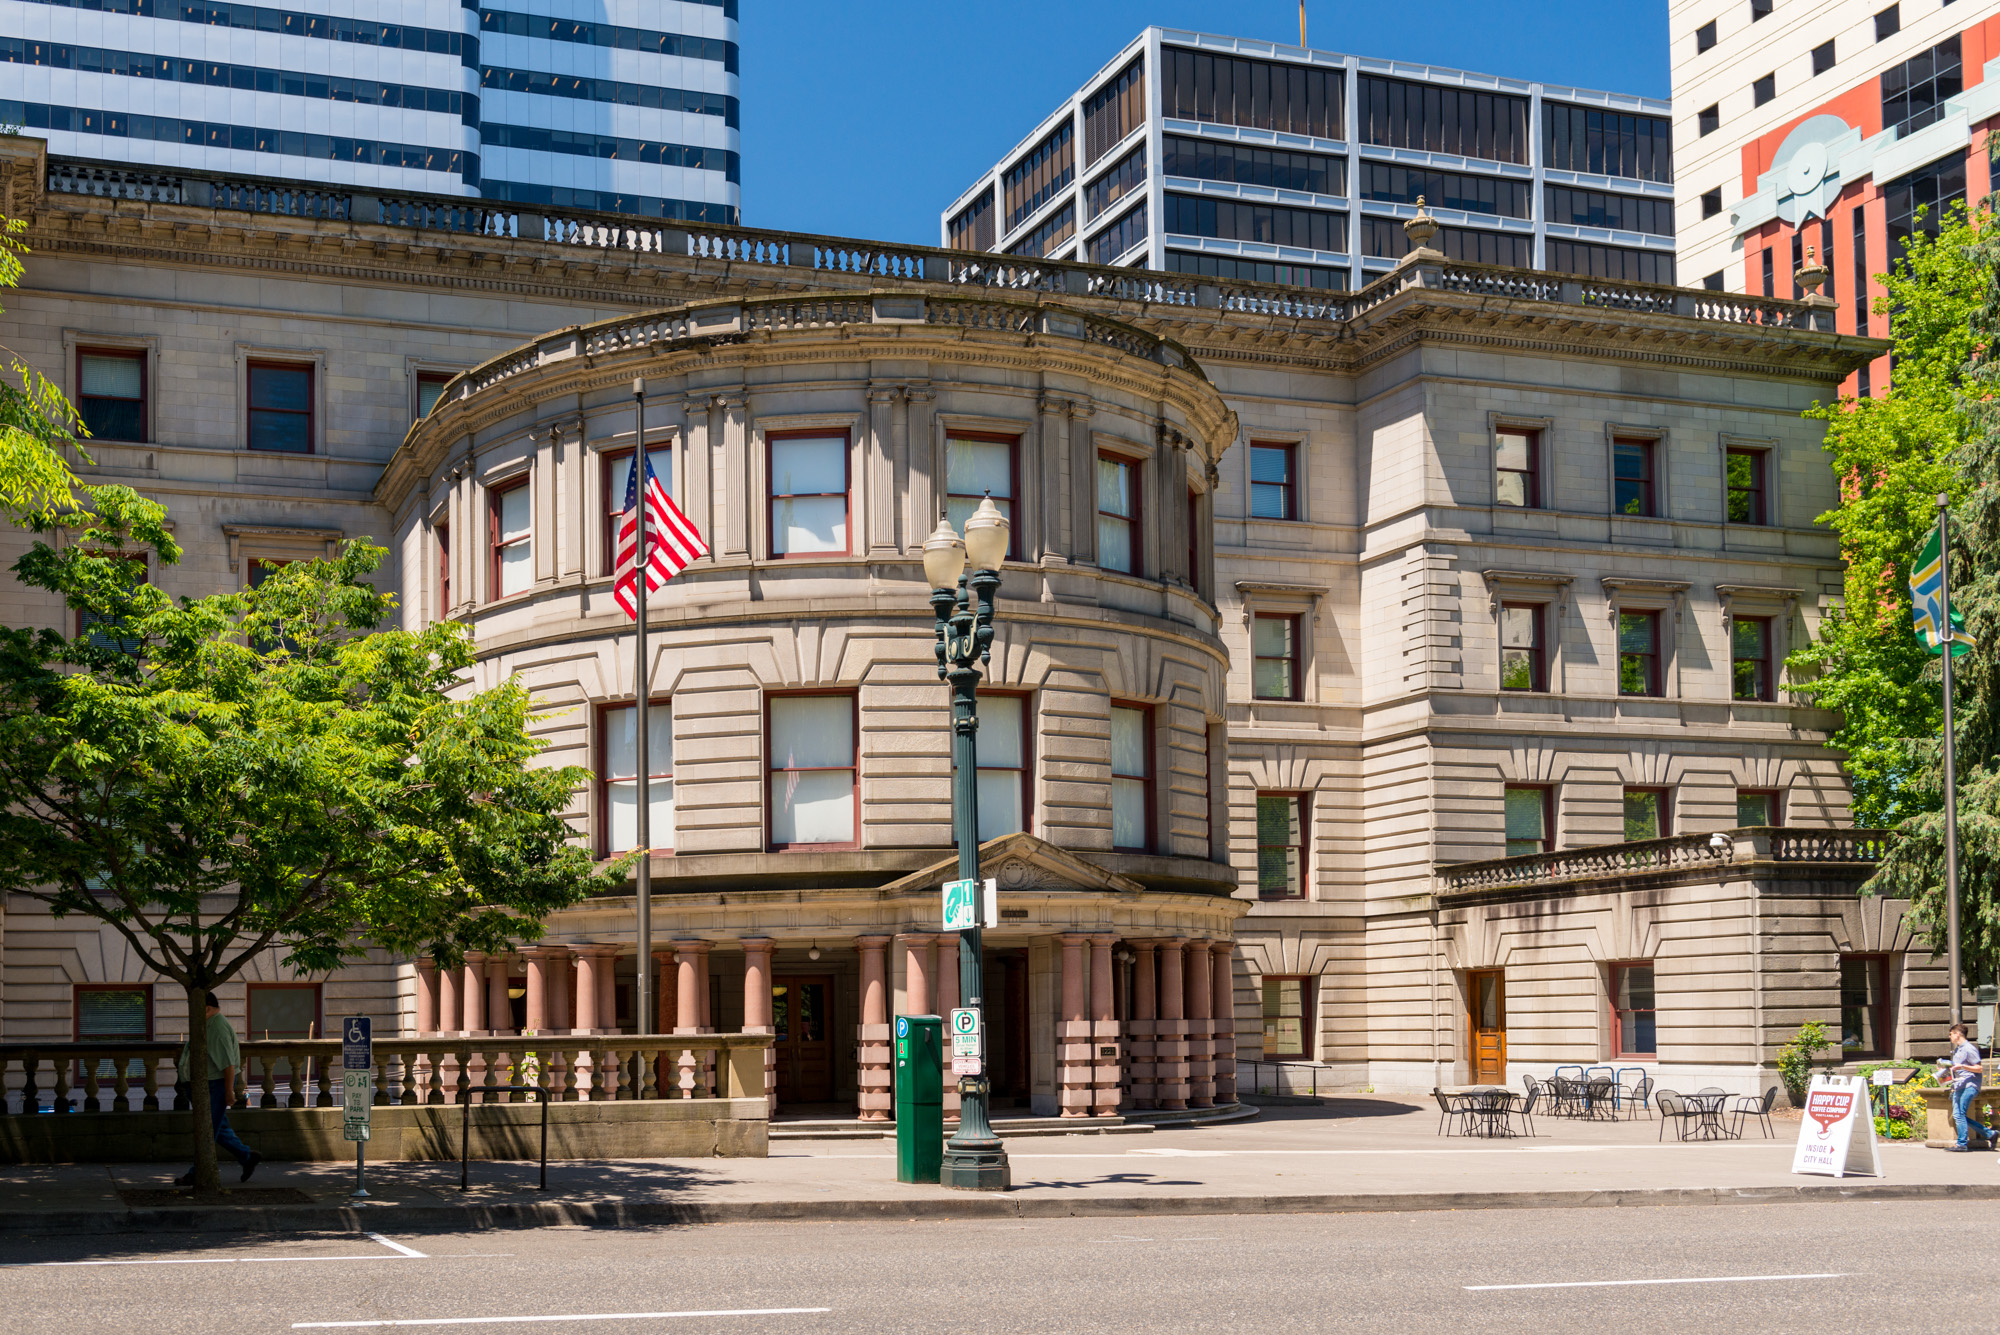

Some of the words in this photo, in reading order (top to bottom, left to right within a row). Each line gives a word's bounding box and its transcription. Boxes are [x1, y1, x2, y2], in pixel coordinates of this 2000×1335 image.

[964, 882, 970, 902] 1
[900, 1022, 905, 1034] P
[962, 1016, 971, 1030] P
[900, 1042, 904, 1054] 1
[1812, 1094, 1836, 1106] HAPPY
[1834, 1096, 1850, 1106] CUP
[1806, 1144, 1827, 1153] INSIDE
[1804, 1155, 1818, 1164] CITY
[1818, 1156, 1832, 1165] HALL
